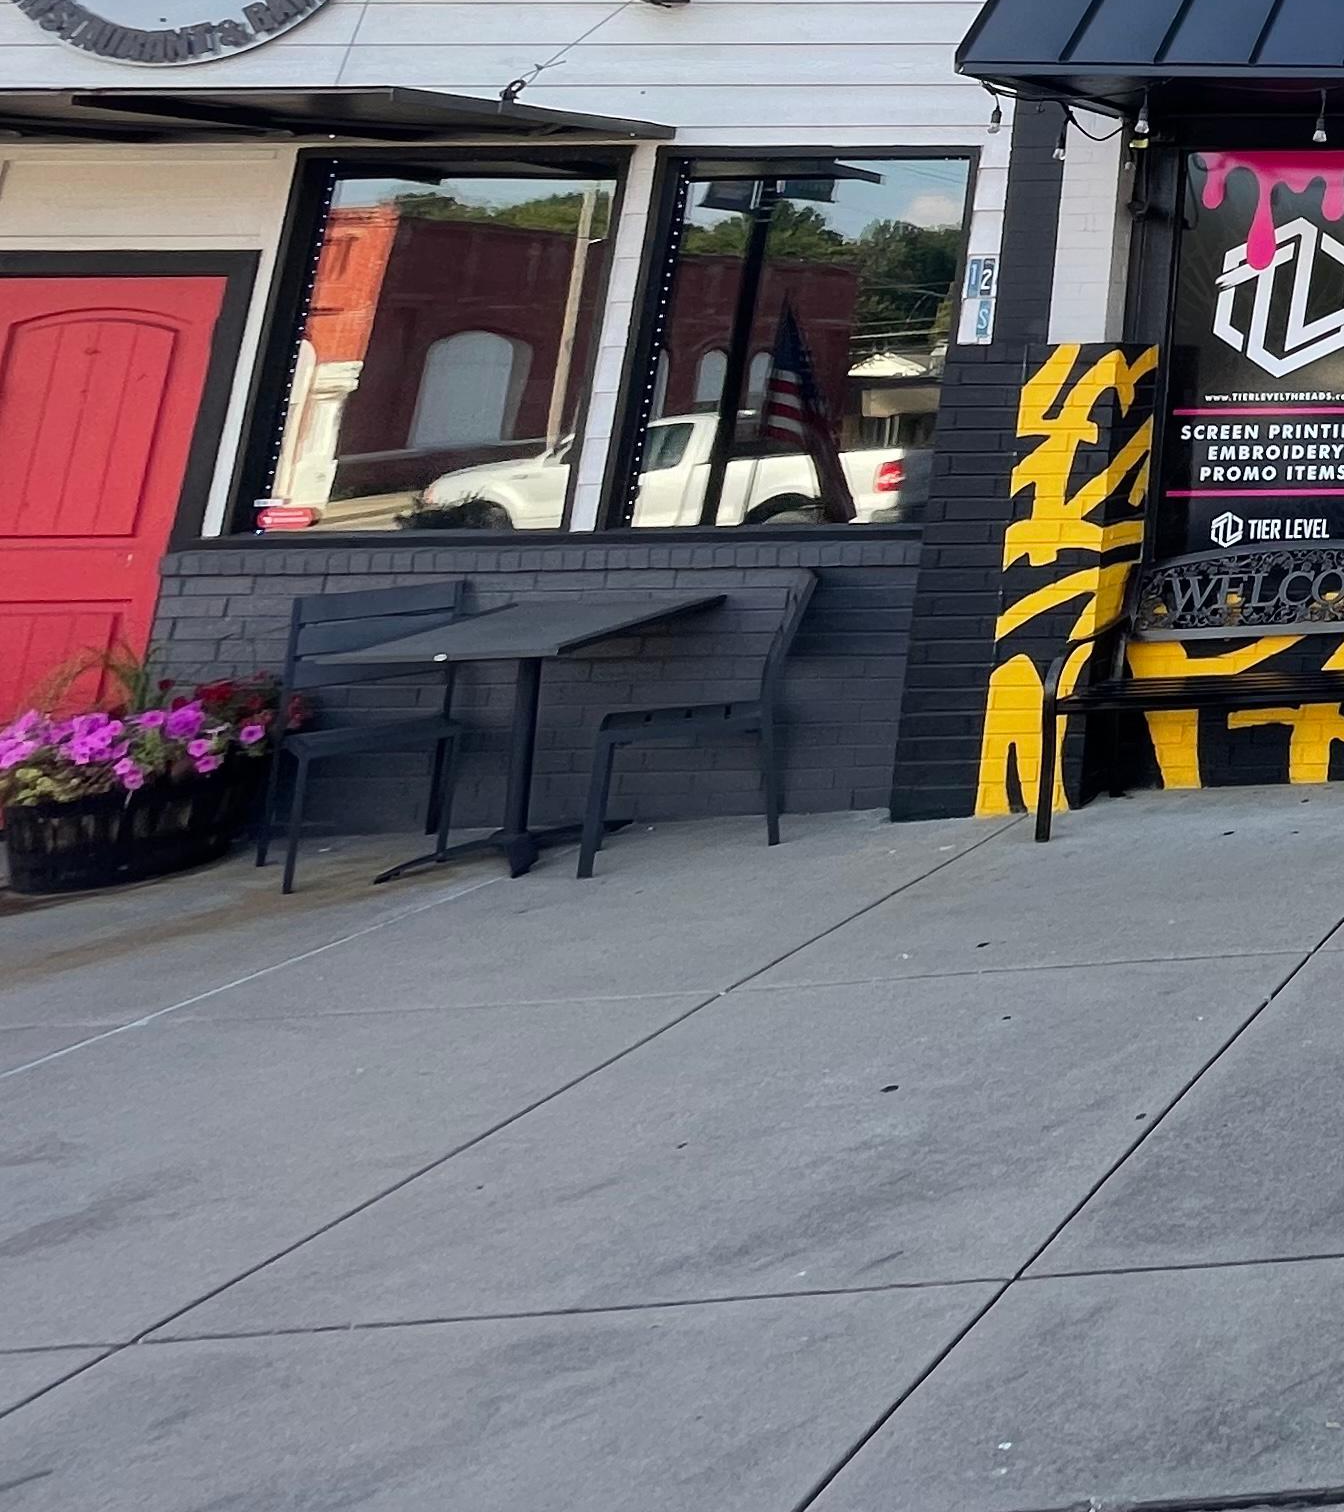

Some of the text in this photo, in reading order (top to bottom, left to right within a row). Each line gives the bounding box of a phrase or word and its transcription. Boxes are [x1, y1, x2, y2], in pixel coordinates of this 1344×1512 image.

[216, 19, 251, 47] &
[970, 264, 994, 291] 12
[1181, 425, 1259, 441] SCREEN
[1207, 444, 1344, 461] EMBROIDERY
[1200, 465, 1278, 483] PROMO
[1248, 519, 1282, 540] TIER
[1285, 518, 1330, 540] LEVEL
